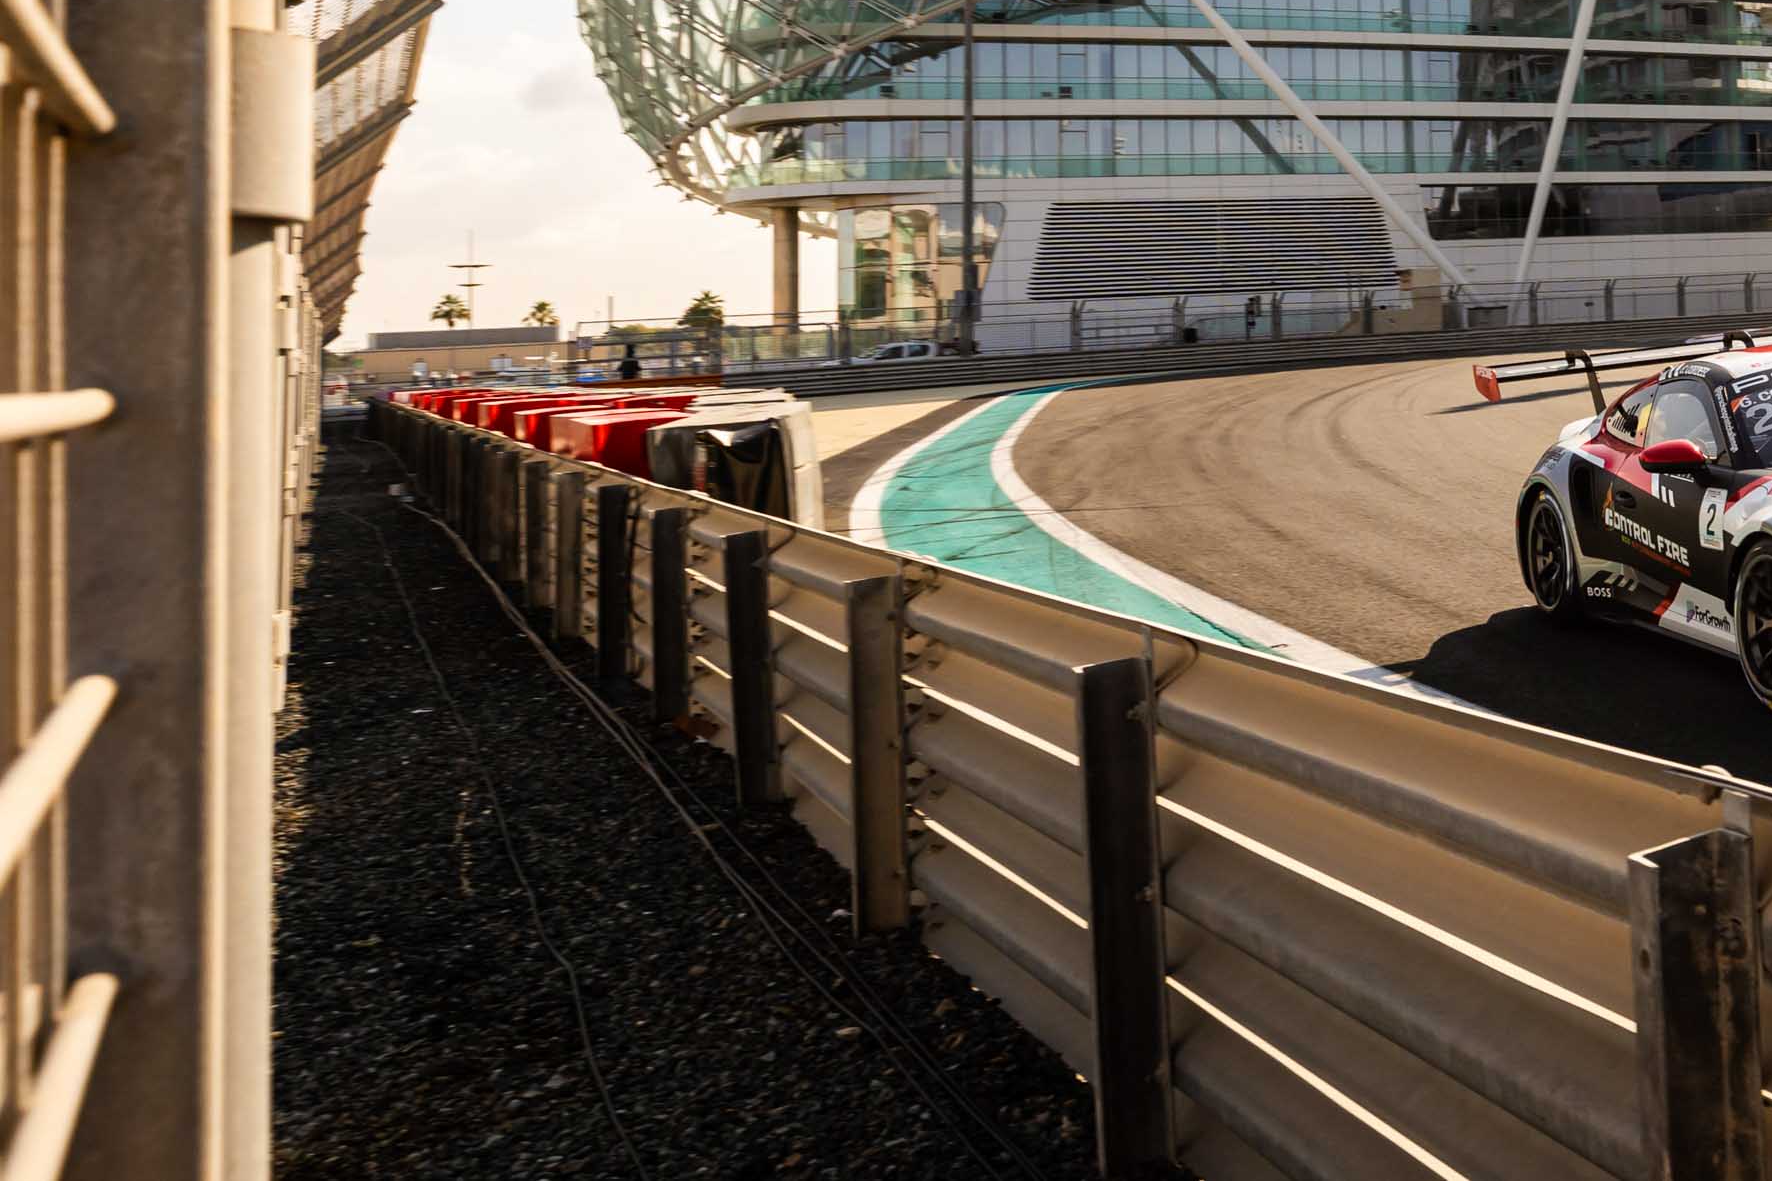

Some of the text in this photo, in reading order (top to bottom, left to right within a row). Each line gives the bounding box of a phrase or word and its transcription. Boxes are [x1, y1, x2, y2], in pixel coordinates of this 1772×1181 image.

[1740, 394, 1757, 408] G.
[1706, 503, 1717, 536] 2
[1604, 507, 1656, 550] CONTROL
[1656, 534, 1690, 567] FIRE
[1586, 586, 1612, 598] BOSS
